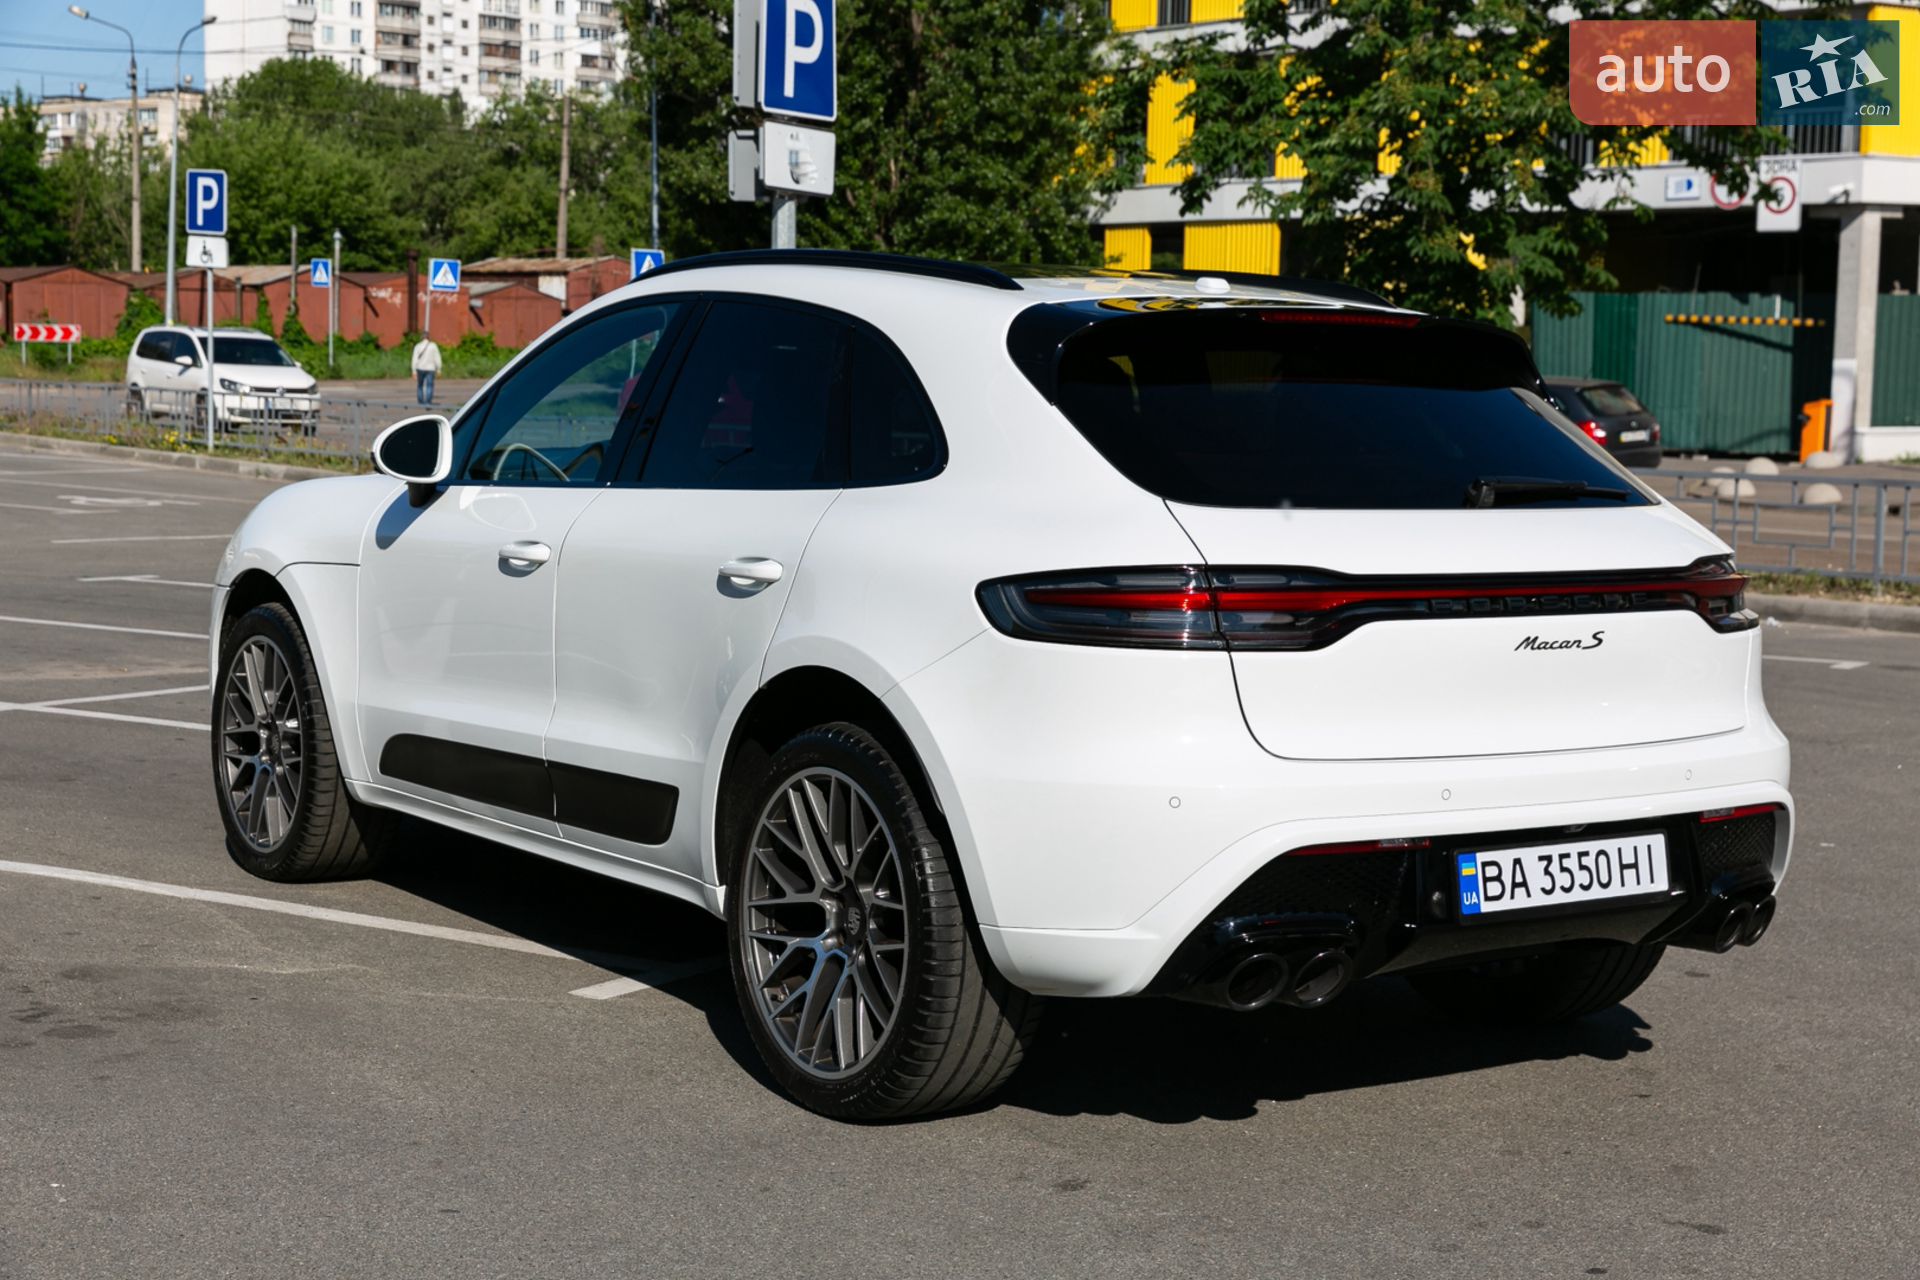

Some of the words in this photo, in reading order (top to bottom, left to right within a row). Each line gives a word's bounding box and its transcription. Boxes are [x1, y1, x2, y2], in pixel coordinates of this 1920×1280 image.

[784, 0, 823, 98] P
[197, 176, 219, 226] P
[1514, 636, 1582, 651] Macan
[1582, 631, 1605, 650] S
[1463, 891, 1479, 905] UA
[1480, 857, 1532, 902] BA
[1537, 849, 1613, 896] 3550
[1617, 844, 1655, 888] HI
